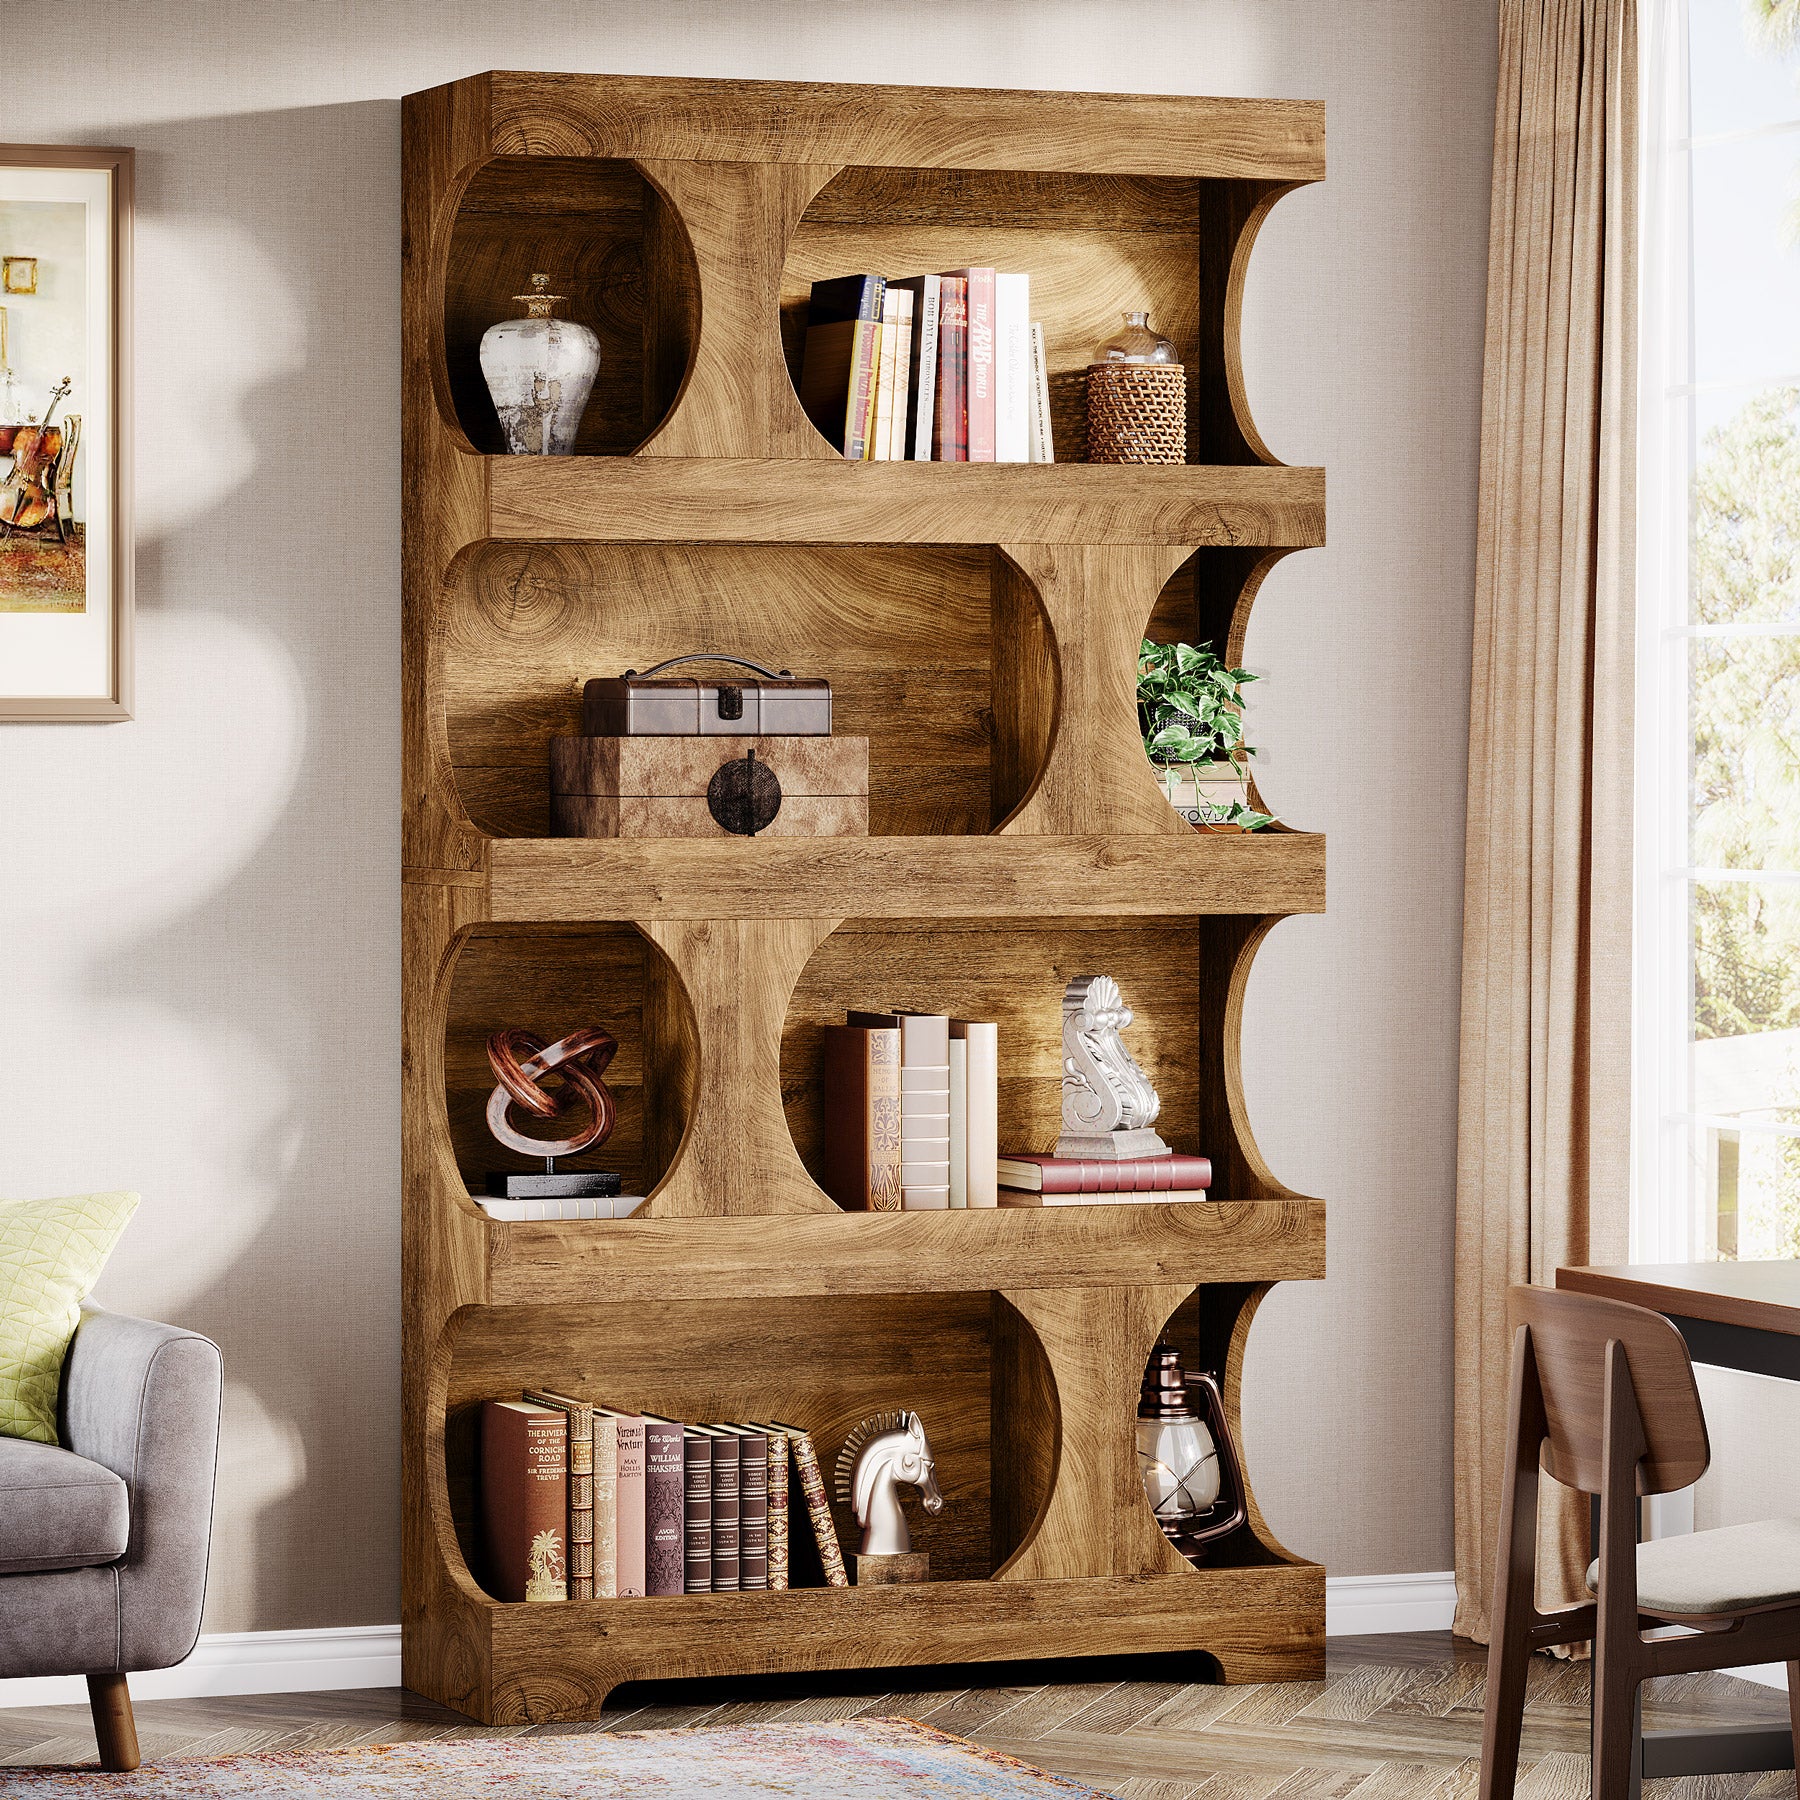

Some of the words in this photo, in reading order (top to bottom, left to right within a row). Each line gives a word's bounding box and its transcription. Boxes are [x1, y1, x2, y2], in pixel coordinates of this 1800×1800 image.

[861, 280, 872, 318] Complete
[927, 297, 935, 316] BOB
[942, 302, 966, 317] English
[976, 303, 987, 322] THE
[926, 319, 934, 352] DYLAN
[973, 318, 992, 364] ARAB
[859, 323, 877, 369] Crossword
[857, 371, 873, 397] Puzzle
[976, 363, 987, 399] WORLD
[528, 1429, 541, 1437] THE
[541, 1428, 567, 1437] RIVIERA
[649, 1435, 661, 1443] The
[661, 1434, 681, 1443] Works
[528, 1446, 566, 1454] CORNICHE
[650, 1454, 681, 1462] WILLIAM
[662, 1444, 670, 1453] of
[647, 1464, 684, 1472] SHAKSPERE
